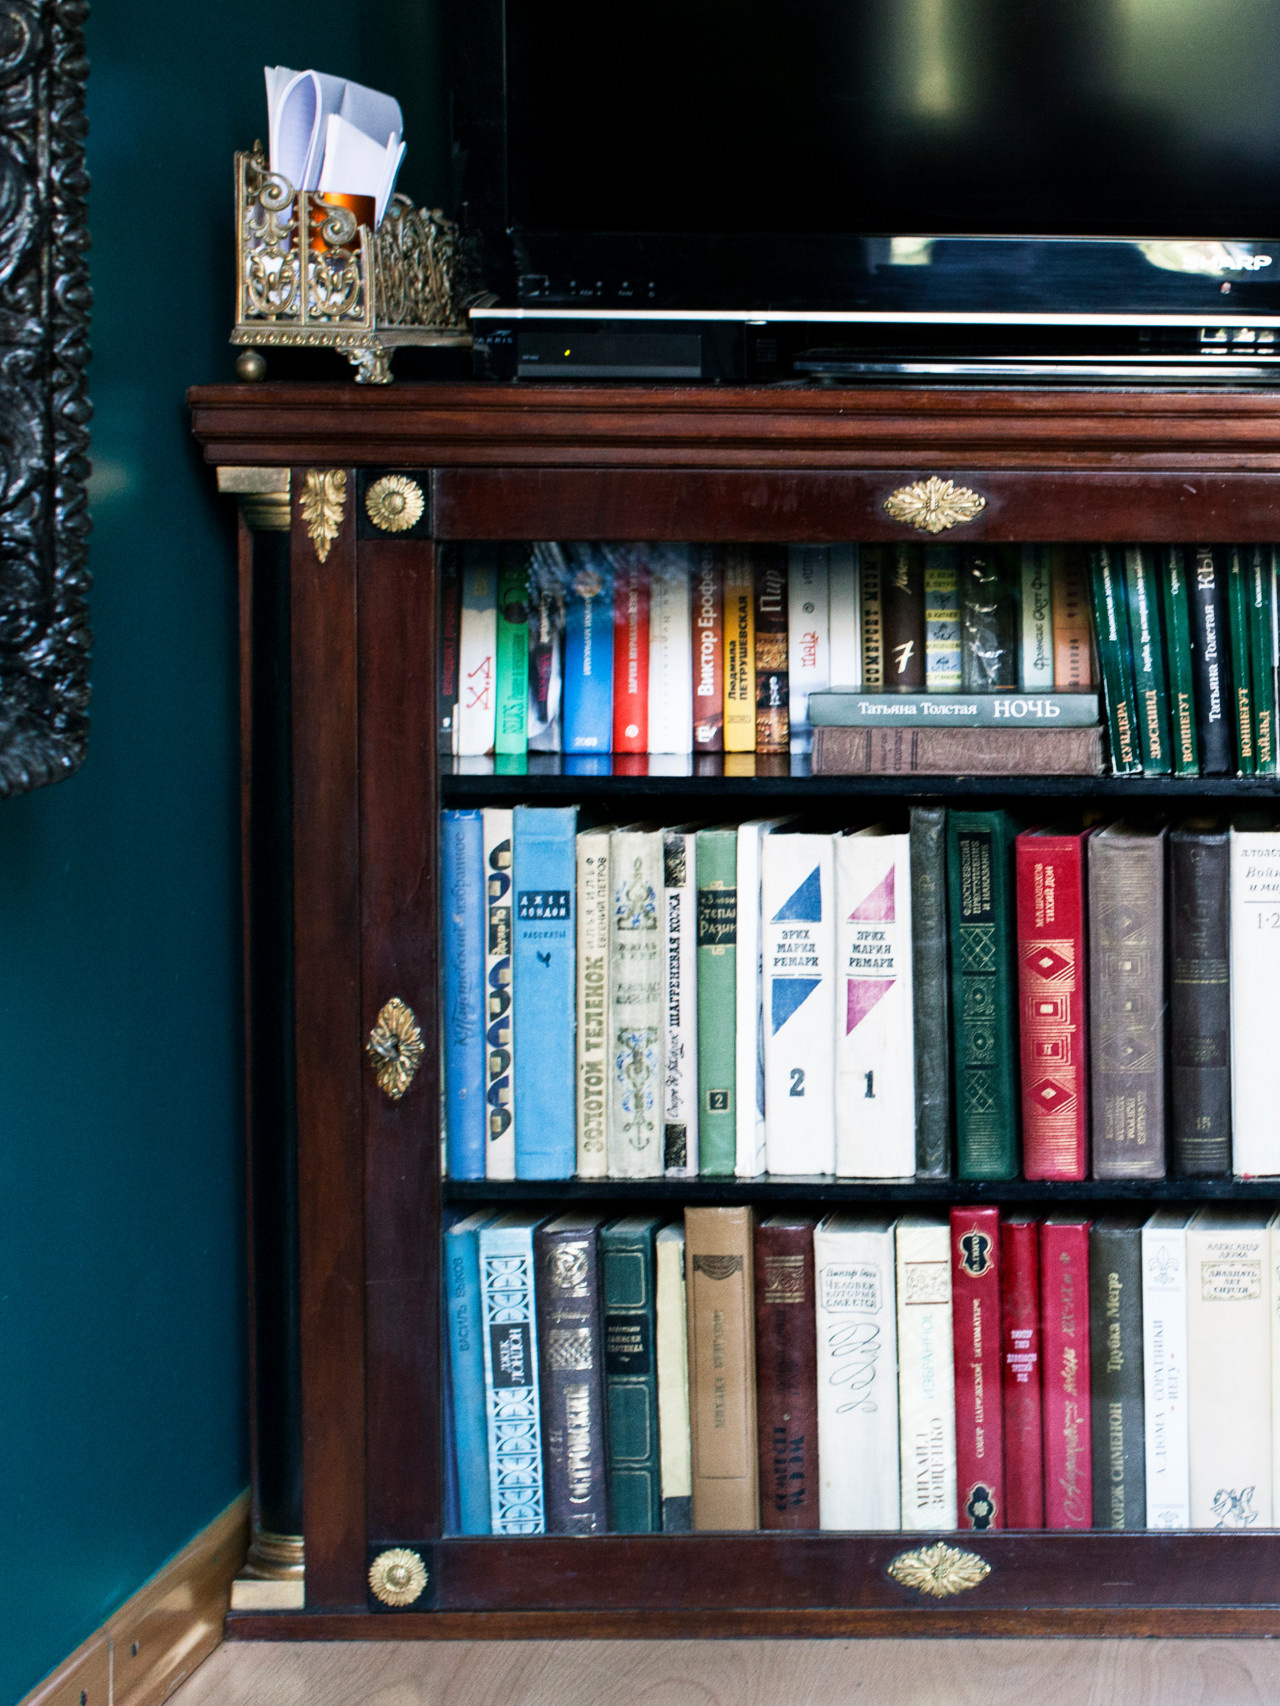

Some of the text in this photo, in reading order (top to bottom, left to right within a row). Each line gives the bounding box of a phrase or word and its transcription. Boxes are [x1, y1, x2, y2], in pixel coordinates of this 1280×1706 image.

[760, 570, 785, 612] Пир
[728, 596, 748, 700] Людмила ПЕТРУШЕВСКАЯ
[1203, 605, 1218, 660] Толстая
[697, 631, 717, 696] Виктор
[857, 700, 1060, 718] Татьяна Толстая НОЧЬ
[1207, 663, 1222, 723] Татьяна
[1116, 701, 1134, 763] КУНДЕРА
[1144, 690, 1161, 759] ЗЮСКИНД
[1178, 693, 1193, 762] ВОННЕГУТ
[1238, 687, 1253, 757] ВОННЕГУТ
[1257, 710, 1271, 763] УАЙЛЬД
[596, 857, 607, 897] ПЕТРОВ
[520, 907, 566, 918] ЛОНДОН
[782, 930, 810, 940] ЭРИХ
[857, 930, 886, 941] ЭРИХ
[774, 956, 819, 967] РЕМАРК
[777, 943, 816, 953] МАРИЯ
[849, 957, 894, 968] РЕМАРК
[852, 944, 892, 955] МАРИЯ
[669, 937, 682, 1027] ШАГРЕНЕВАЯ
[580, 956, 605, 1153] ЗОЛОТОЙ ТЕЛЕНОК
[713, 1094, 724, 1108] 2
[789, 1068, 805, 1097] 2
[864, 1070, 876, 1098] 1
[1105, 1272, 1122, 1319] Мегрэ
[921, 1312, 934, 1400] ИЗБРАННОЕ
[1106, 1323, 1123, 1374] Трубка
[970, 1363, 984, 1423] ПАРИЖСКОЙ
[563, 1384, 592, 1503] ОСТРОВСКИЙ
[930, 1417, 946, 1509] ЗОЩЕНКО
[974, 1428, 985, 1459] СОБОР
[1109, 1402, 1125, 1481] СИМЕНОН
[917, 1434, 931, 1509] МИХАИЛ
